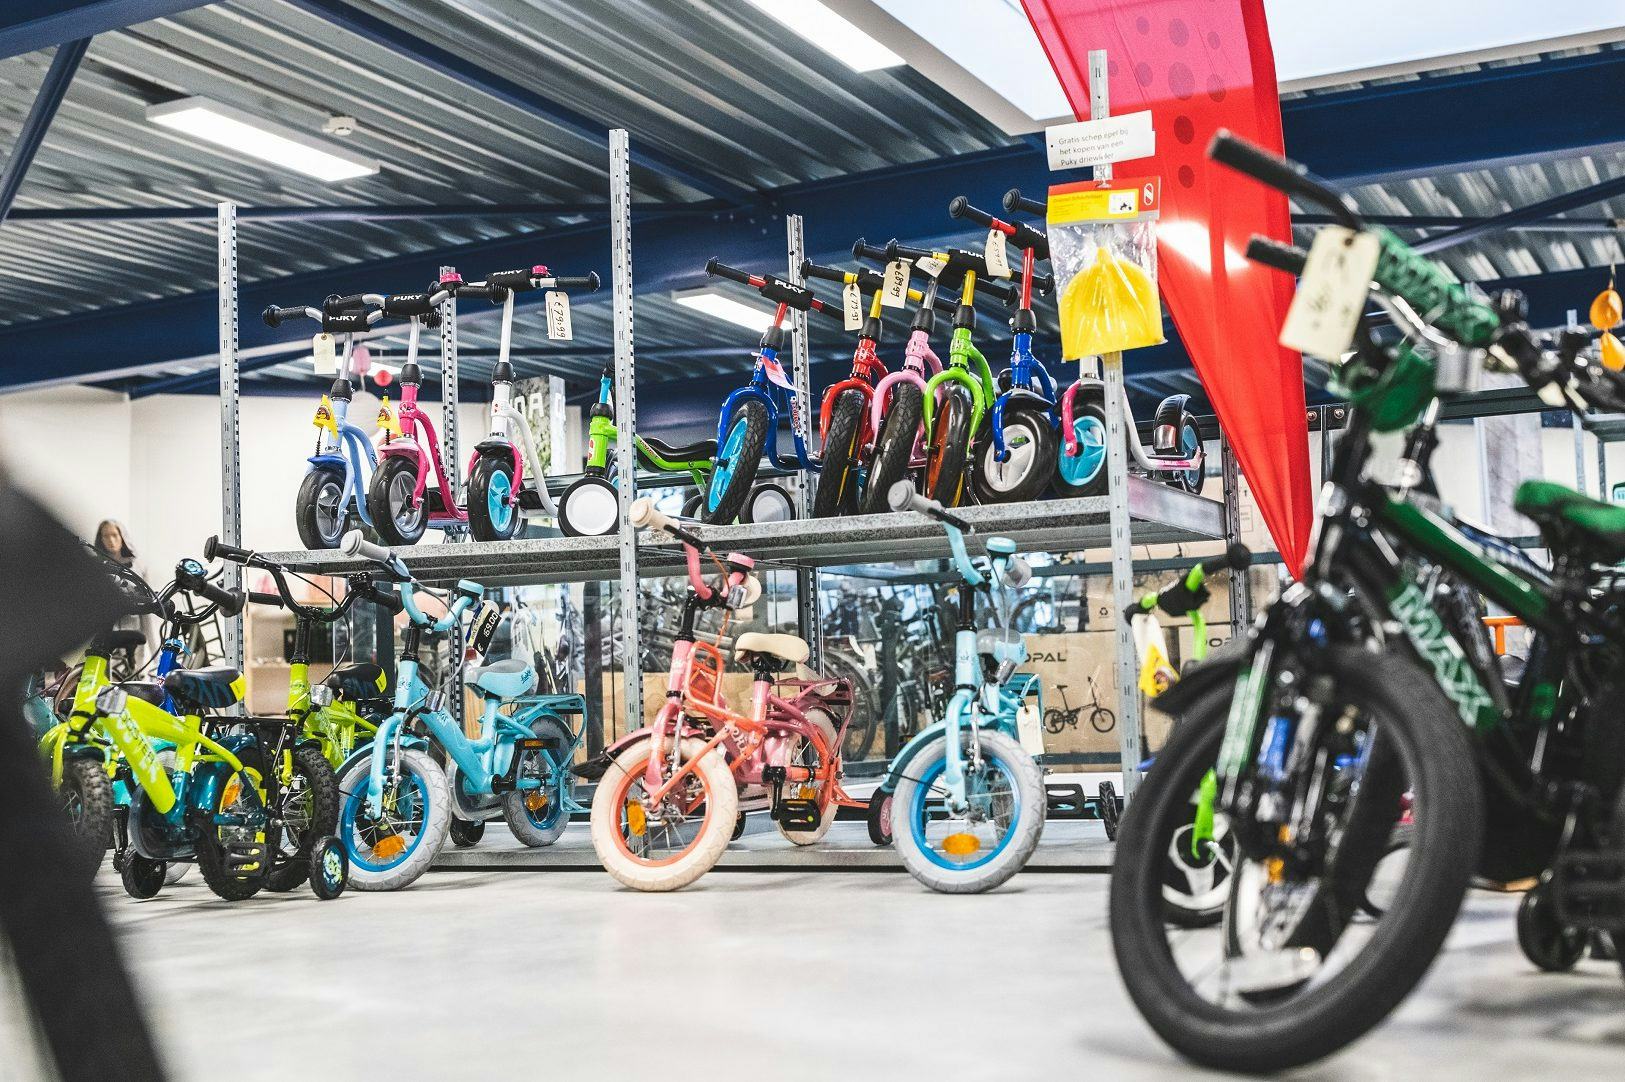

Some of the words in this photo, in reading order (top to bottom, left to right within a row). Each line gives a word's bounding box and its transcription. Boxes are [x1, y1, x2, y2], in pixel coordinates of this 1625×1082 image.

[960, 249, 984, 259] PUK
[868, 269, 886, 278] PU
[775, 279, 806, 294] PUKY
[393, 294, 423, 302] PUKY
